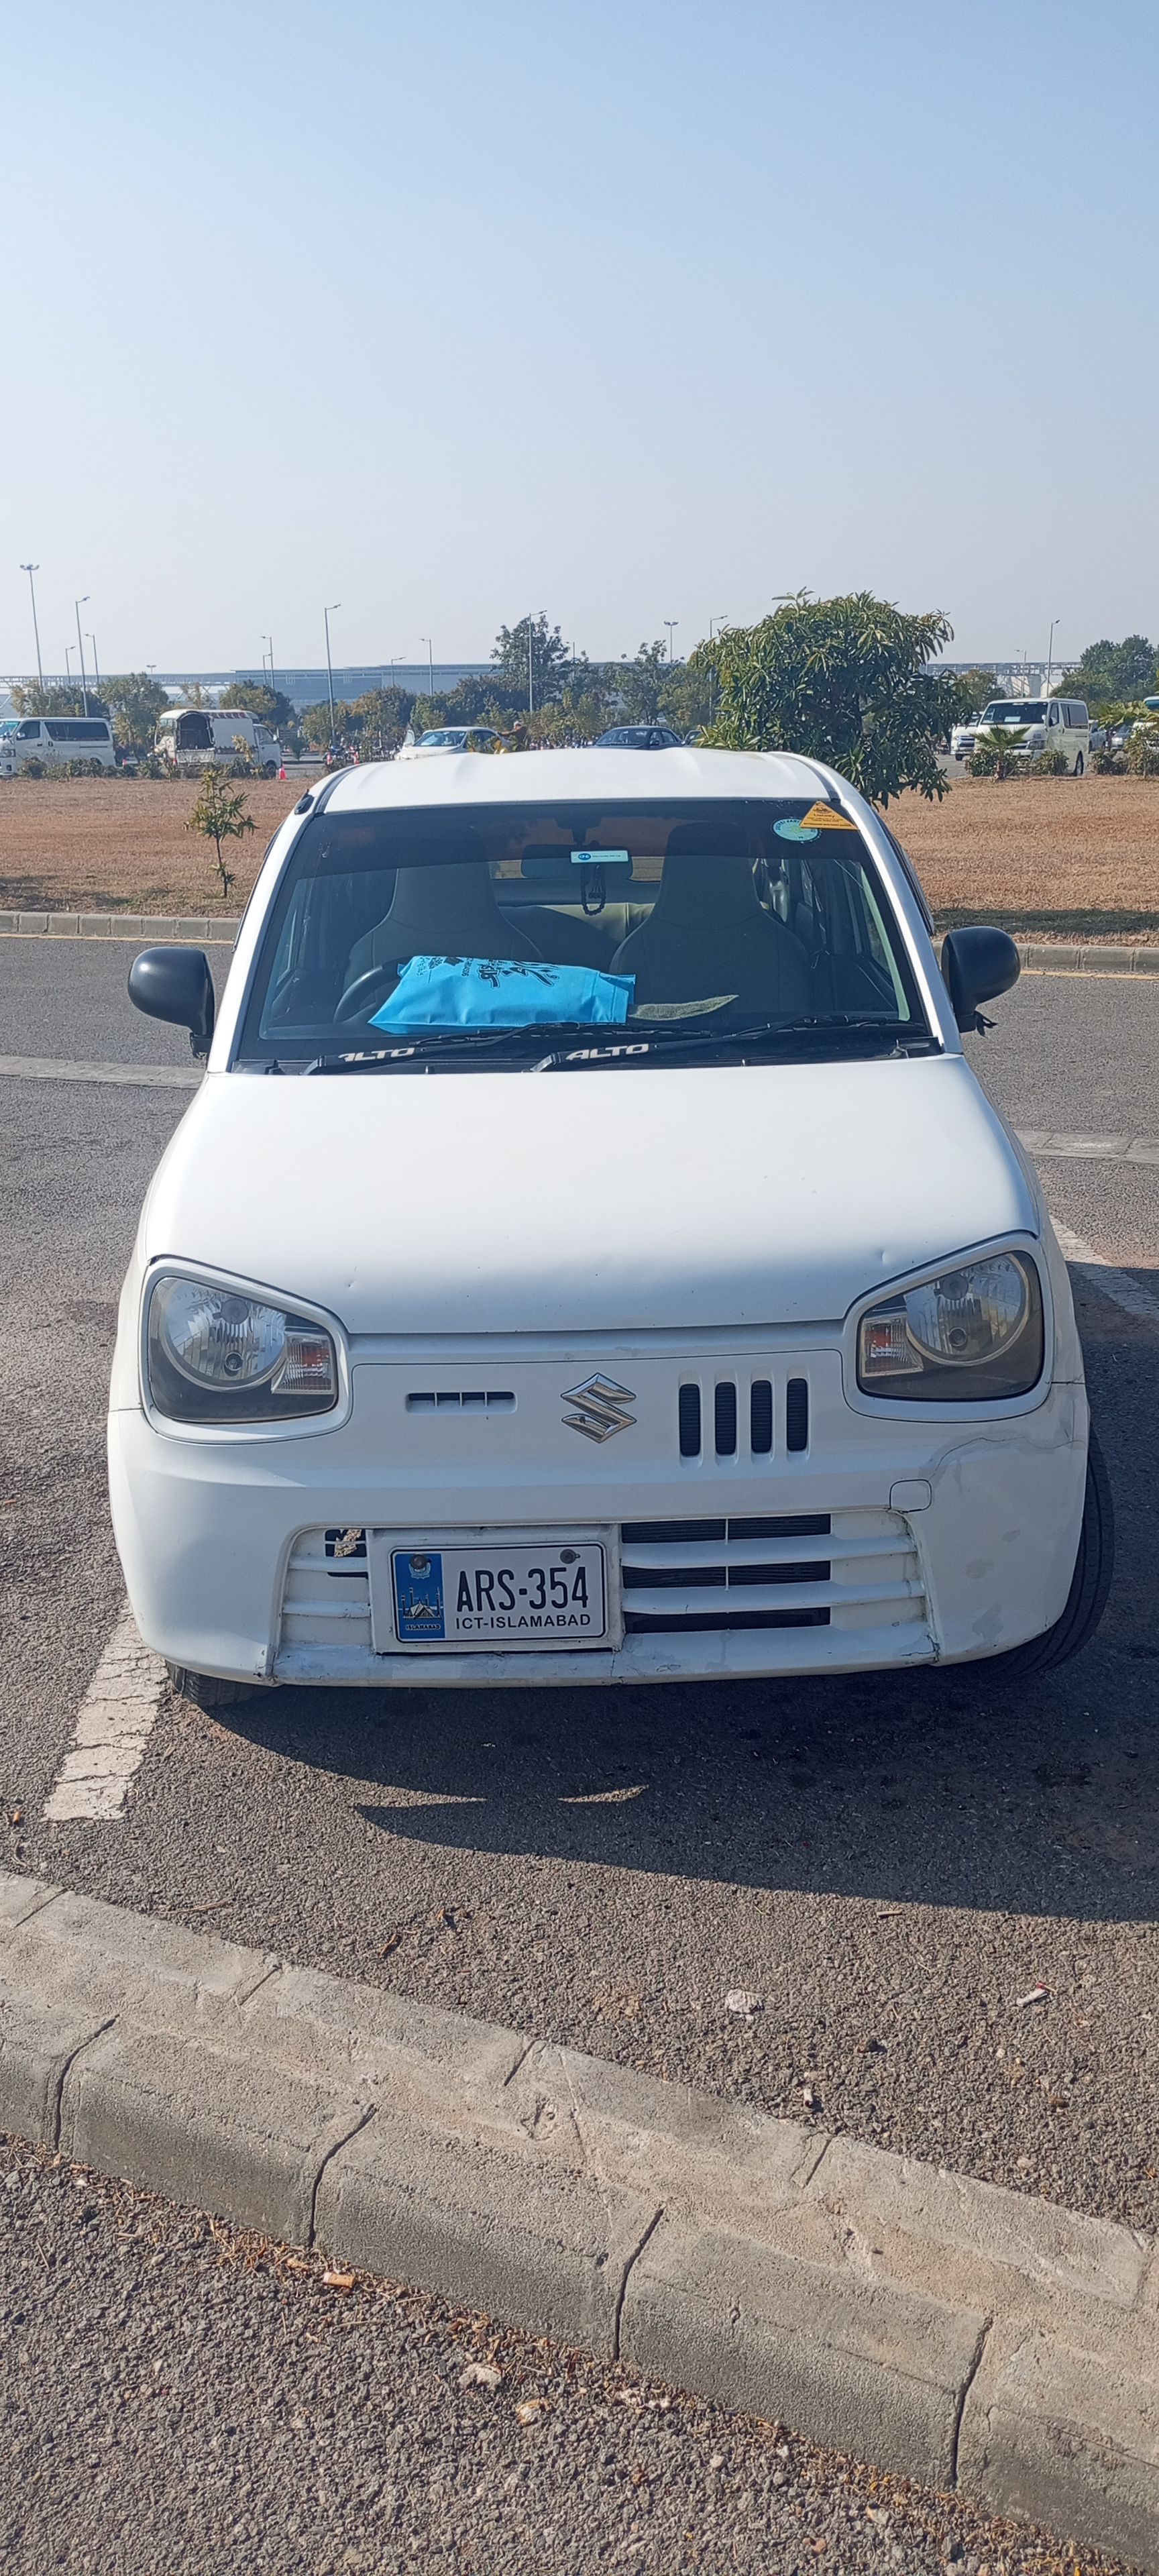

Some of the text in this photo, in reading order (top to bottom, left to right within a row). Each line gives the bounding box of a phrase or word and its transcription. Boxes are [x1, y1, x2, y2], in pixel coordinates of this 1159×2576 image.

[565, 1043, 649, 1063] ALTO
[456, 1566, 589, 1613] ARS-354
[455, 1613, 591, 1630] ICT-ISLAMABAD
